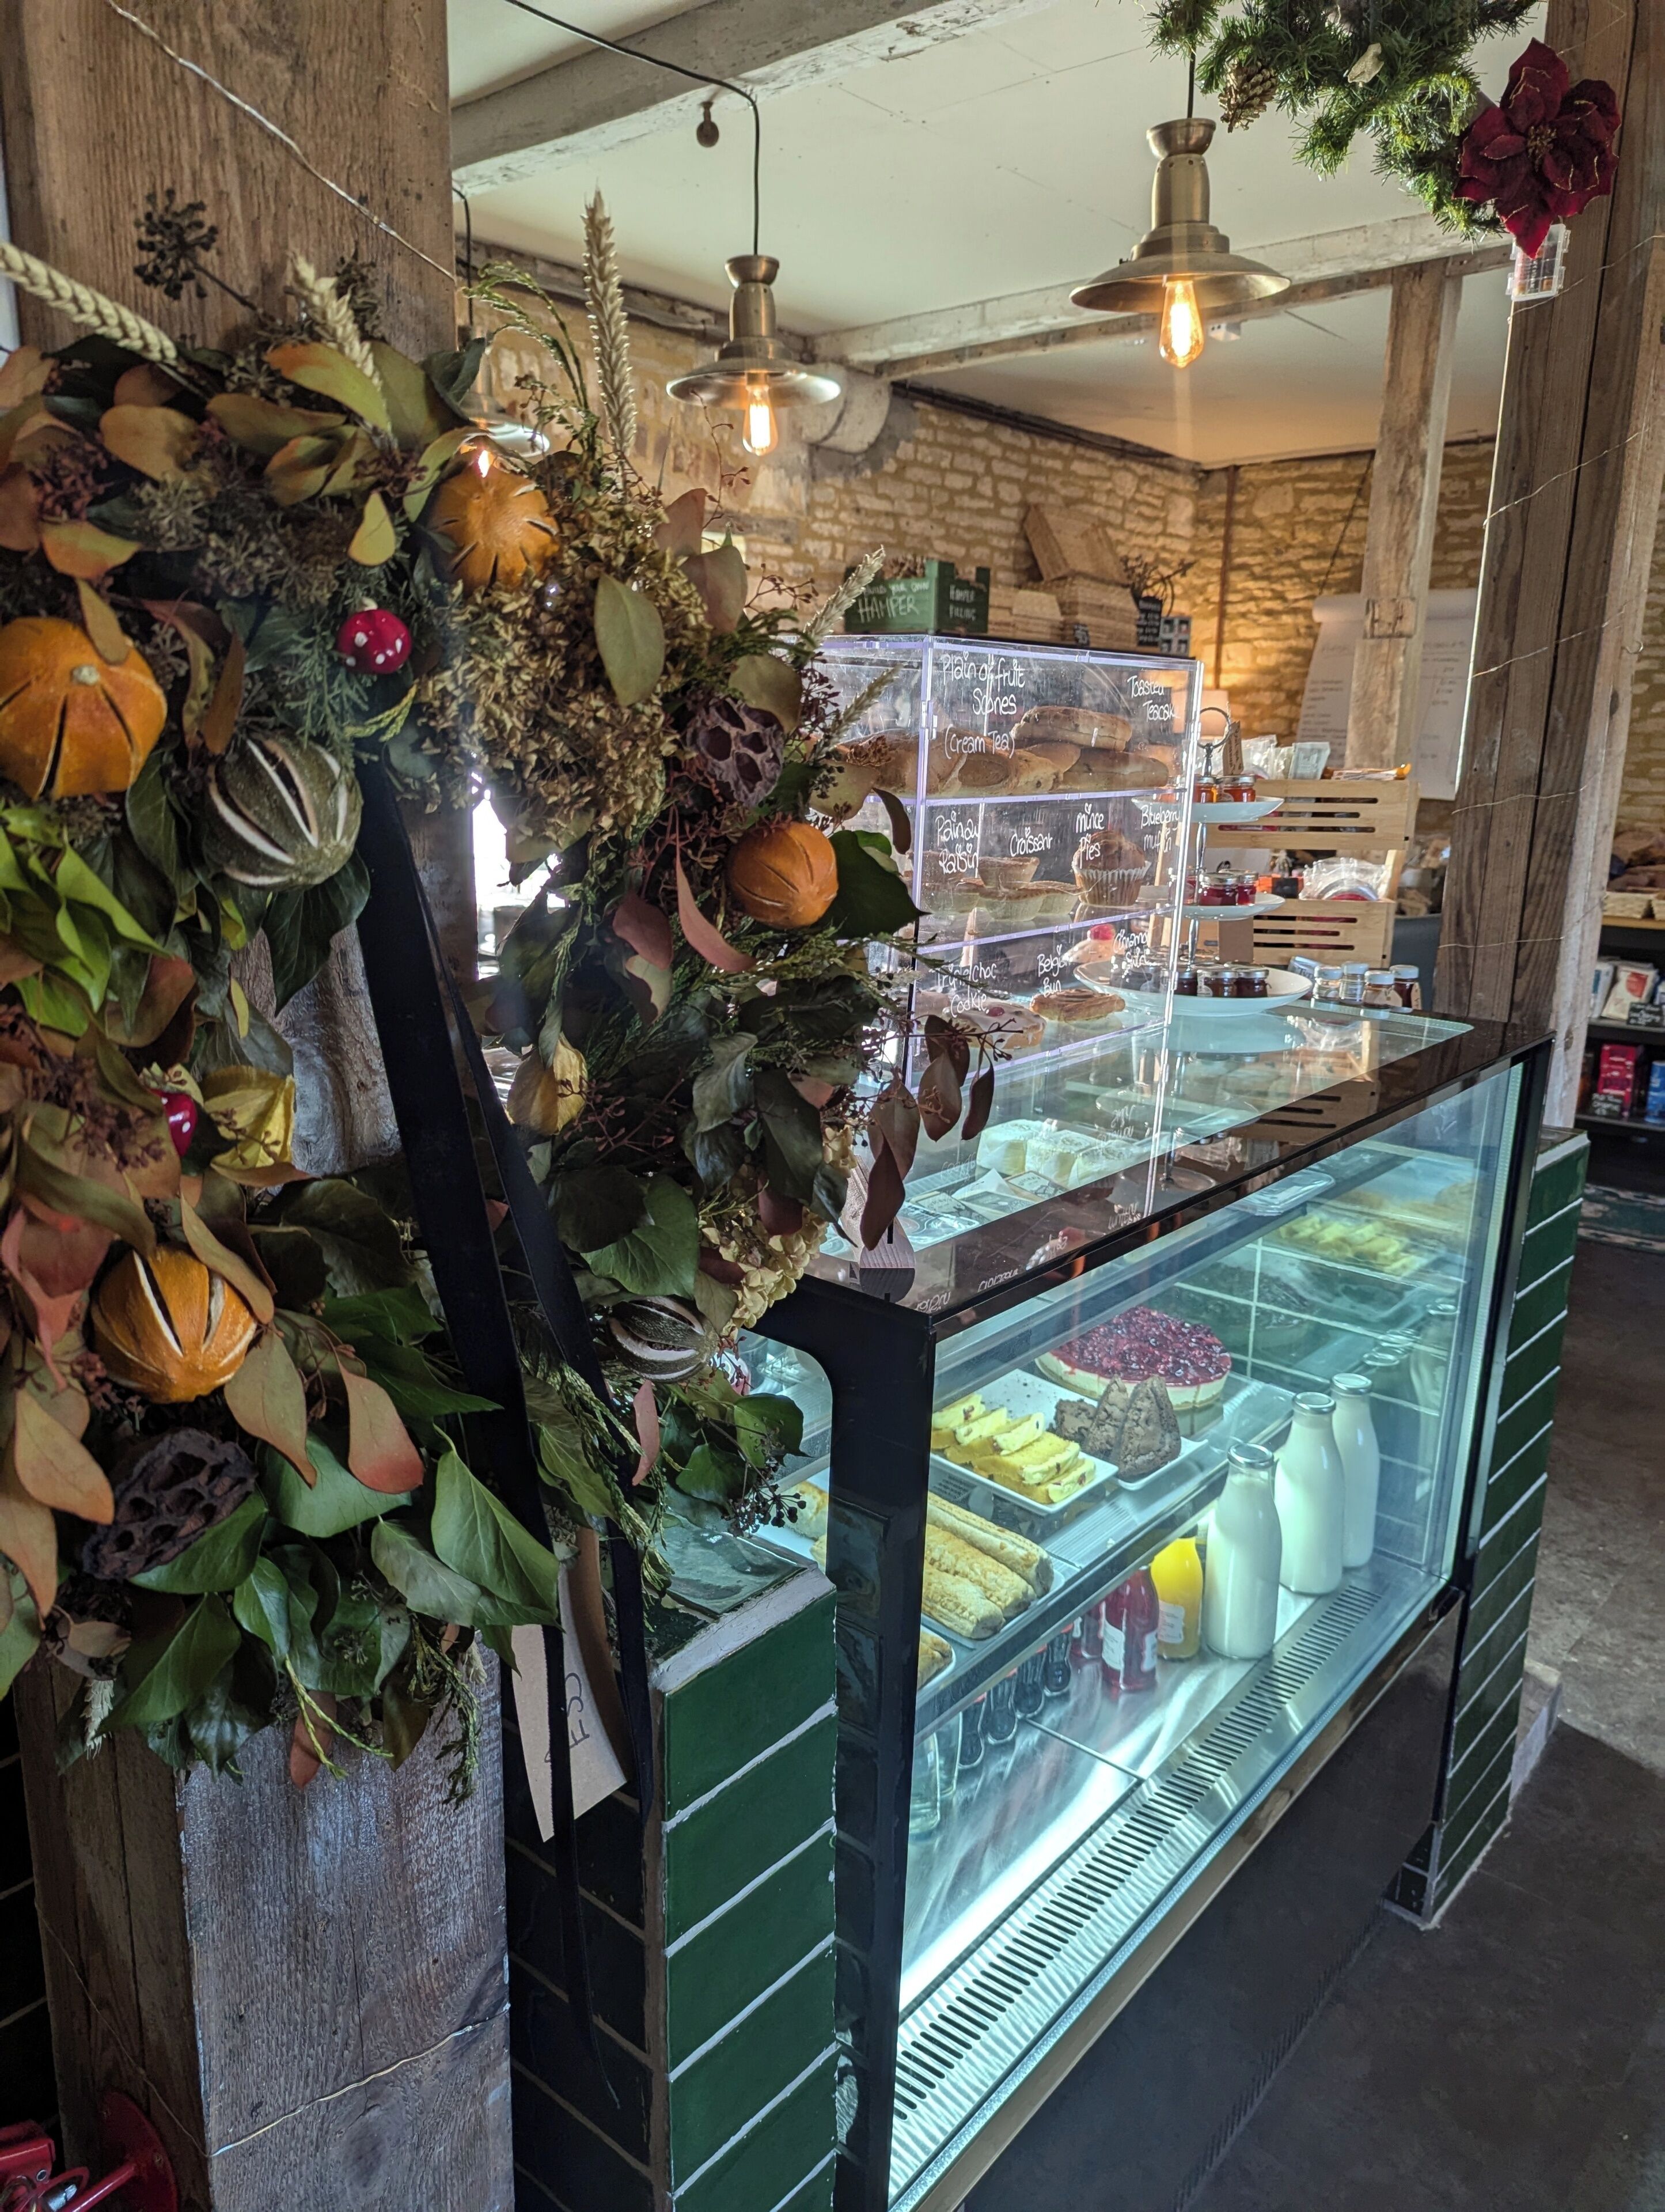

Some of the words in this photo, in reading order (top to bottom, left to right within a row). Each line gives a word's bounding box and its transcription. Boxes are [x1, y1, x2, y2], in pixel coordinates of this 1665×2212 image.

[858, 594, 920, 623] HAMPER
[940, 650, 977, 685] Plain
[995, 657, 1025, 692] fruit
[972, 688, 1017, 715] Scones
[1142, 700, 1181, 722] Teacak
[1010, 826, 1053, 857] Croissant
[1144, 827, 1173, 853] mufin
[1043, 977, 1061, 998] Bun
